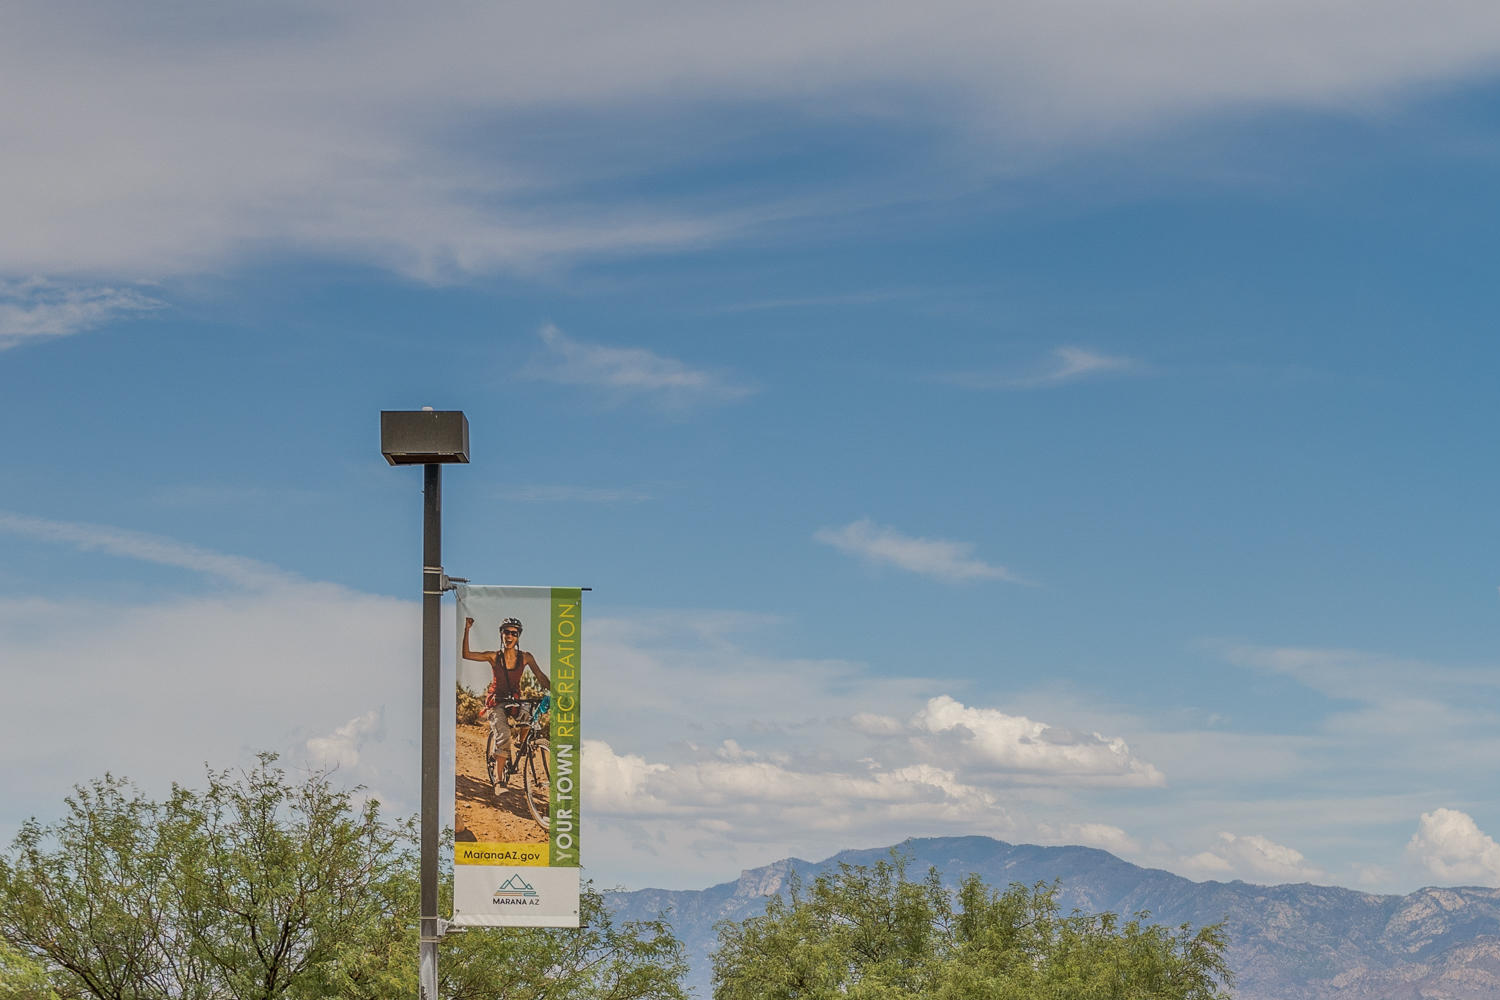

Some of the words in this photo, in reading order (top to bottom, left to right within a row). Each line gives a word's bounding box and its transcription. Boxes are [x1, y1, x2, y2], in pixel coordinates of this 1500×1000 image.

[557, 604, 575, 737] RECREATION
[556, 744, 573, 802] TOWN
[463, 850, 540, 862] MaranaAZ.gov
[556, 809, 573, 862] YOUR
[528, 898, 540, 906] AZ
